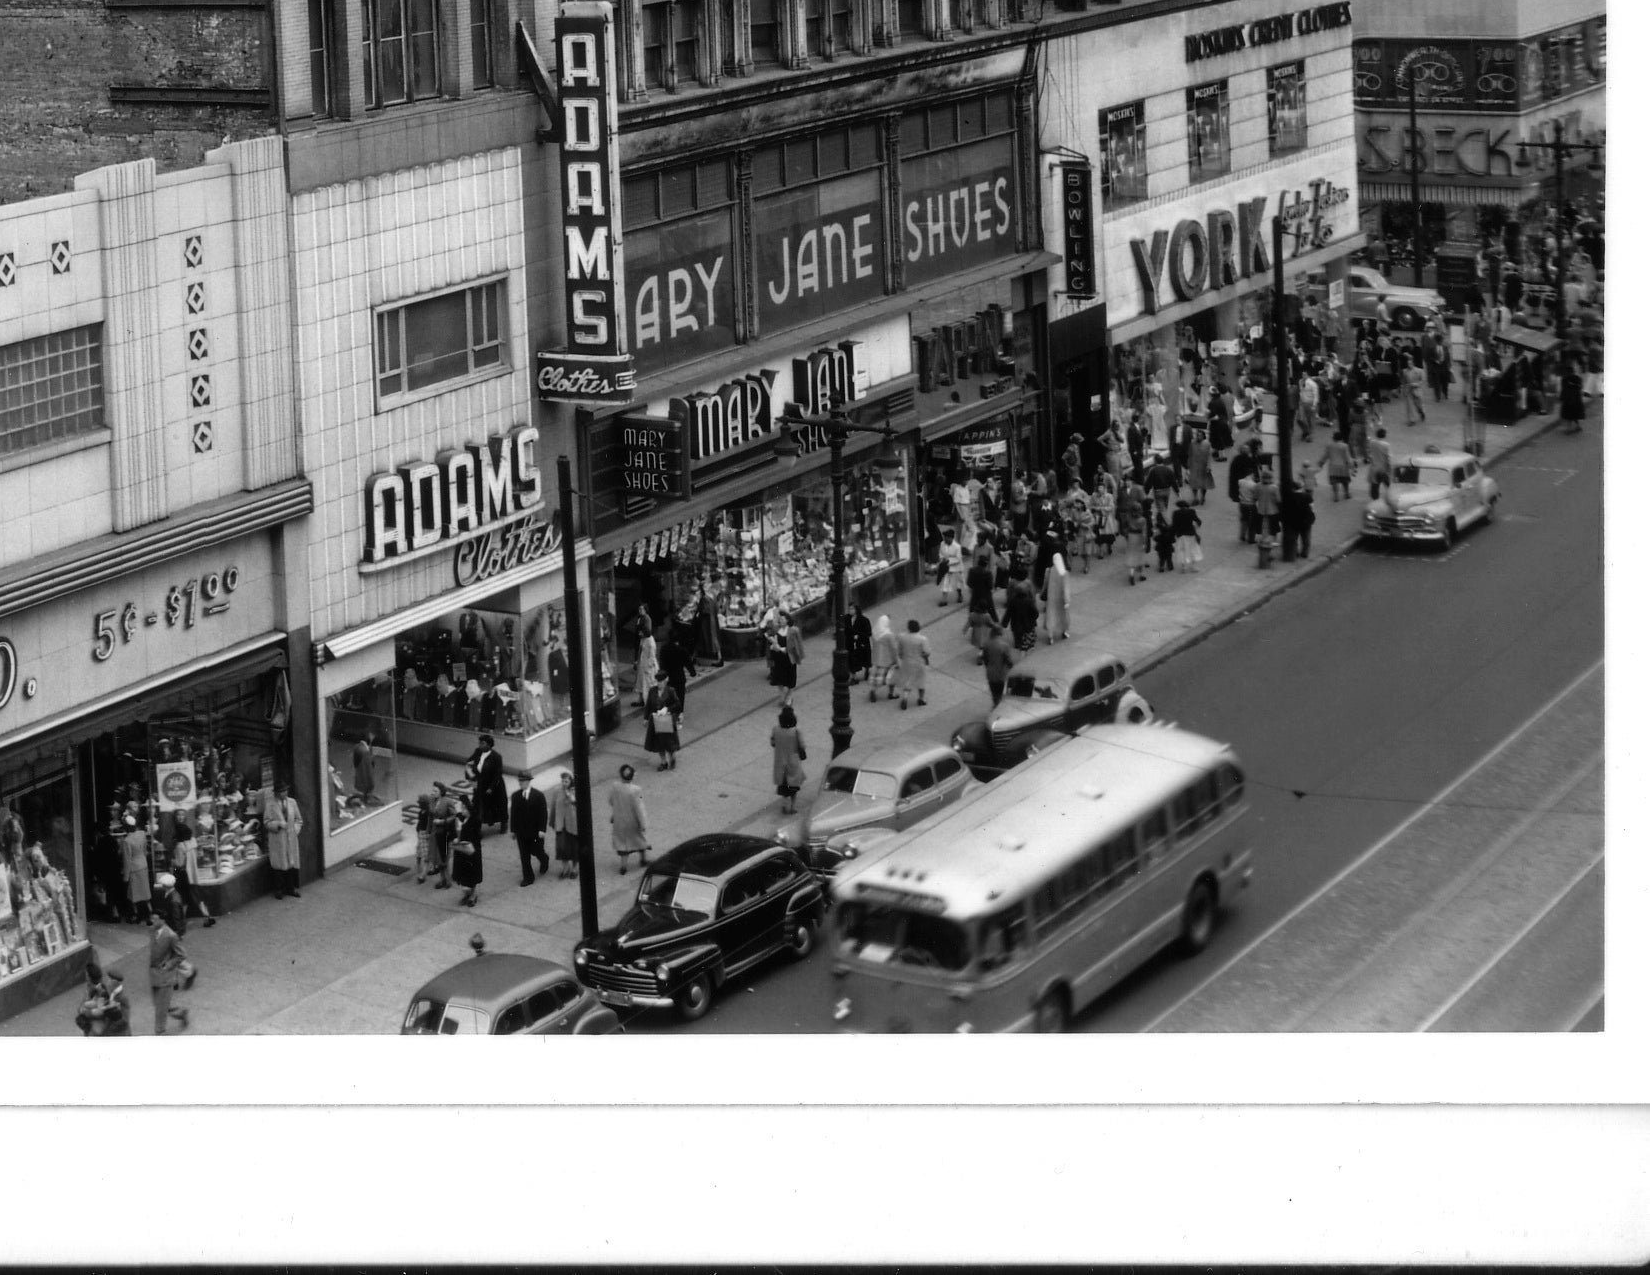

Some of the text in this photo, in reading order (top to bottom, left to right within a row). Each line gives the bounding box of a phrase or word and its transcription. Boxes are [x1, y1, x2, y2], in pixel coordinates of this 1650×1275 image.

[561, 32, 610, 345] ADAMS
[1067, 174, 1085, 290] BOWLING
[635, 176, 1011, 349] ARY JANE SHOES
[1129, 196, 1271, 315] YORK
[538, 366, 614, 396] Clothes
[623, 428, 667, 447] MARY
[690, 340, 868, 459] MARY JANE
[364, 426, 542, 563] ADAMS
[624, 451, 667, 471] JANE
[625, 474, 669, 494] SHOES
[455, 515, 563, 587] Clothes
